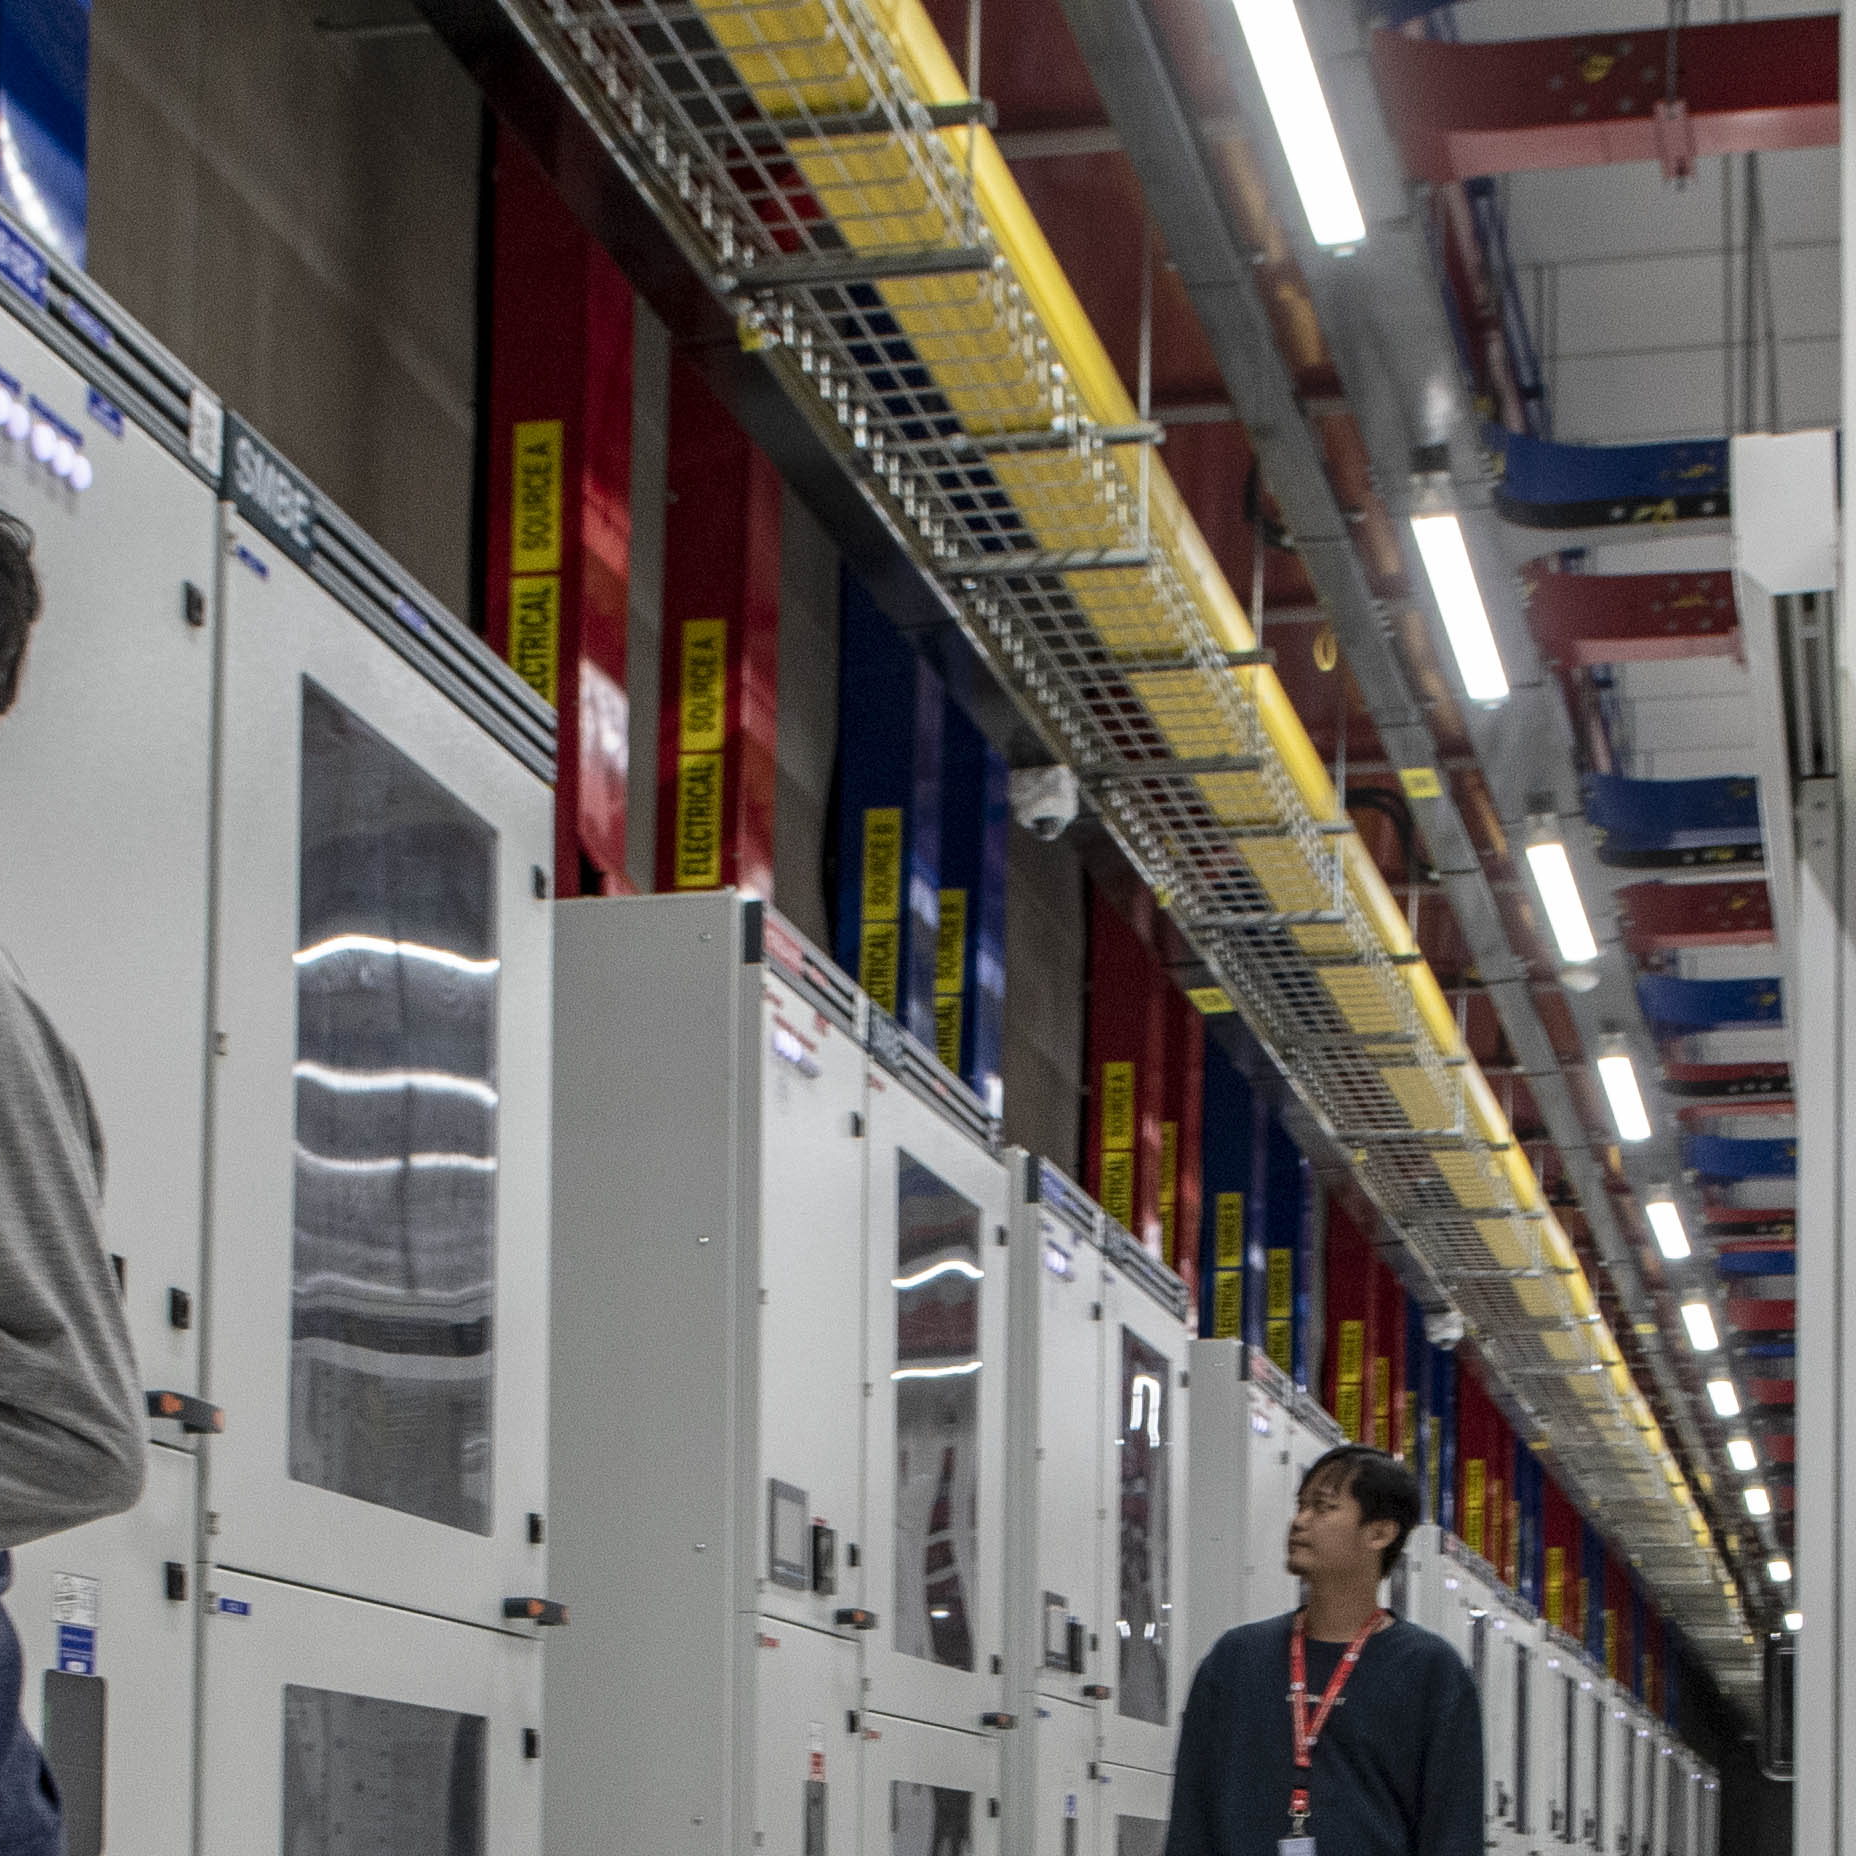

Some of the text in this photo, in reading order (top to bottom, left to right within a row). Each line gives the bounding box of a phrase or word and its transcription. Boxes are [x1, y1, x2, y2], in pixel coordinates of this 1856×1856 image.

[517, 587, 552, 700] ECTRICAL
[686, 656, 716, 734] SOURCE
[679, 763, 714, 877] ELECTRICAL
